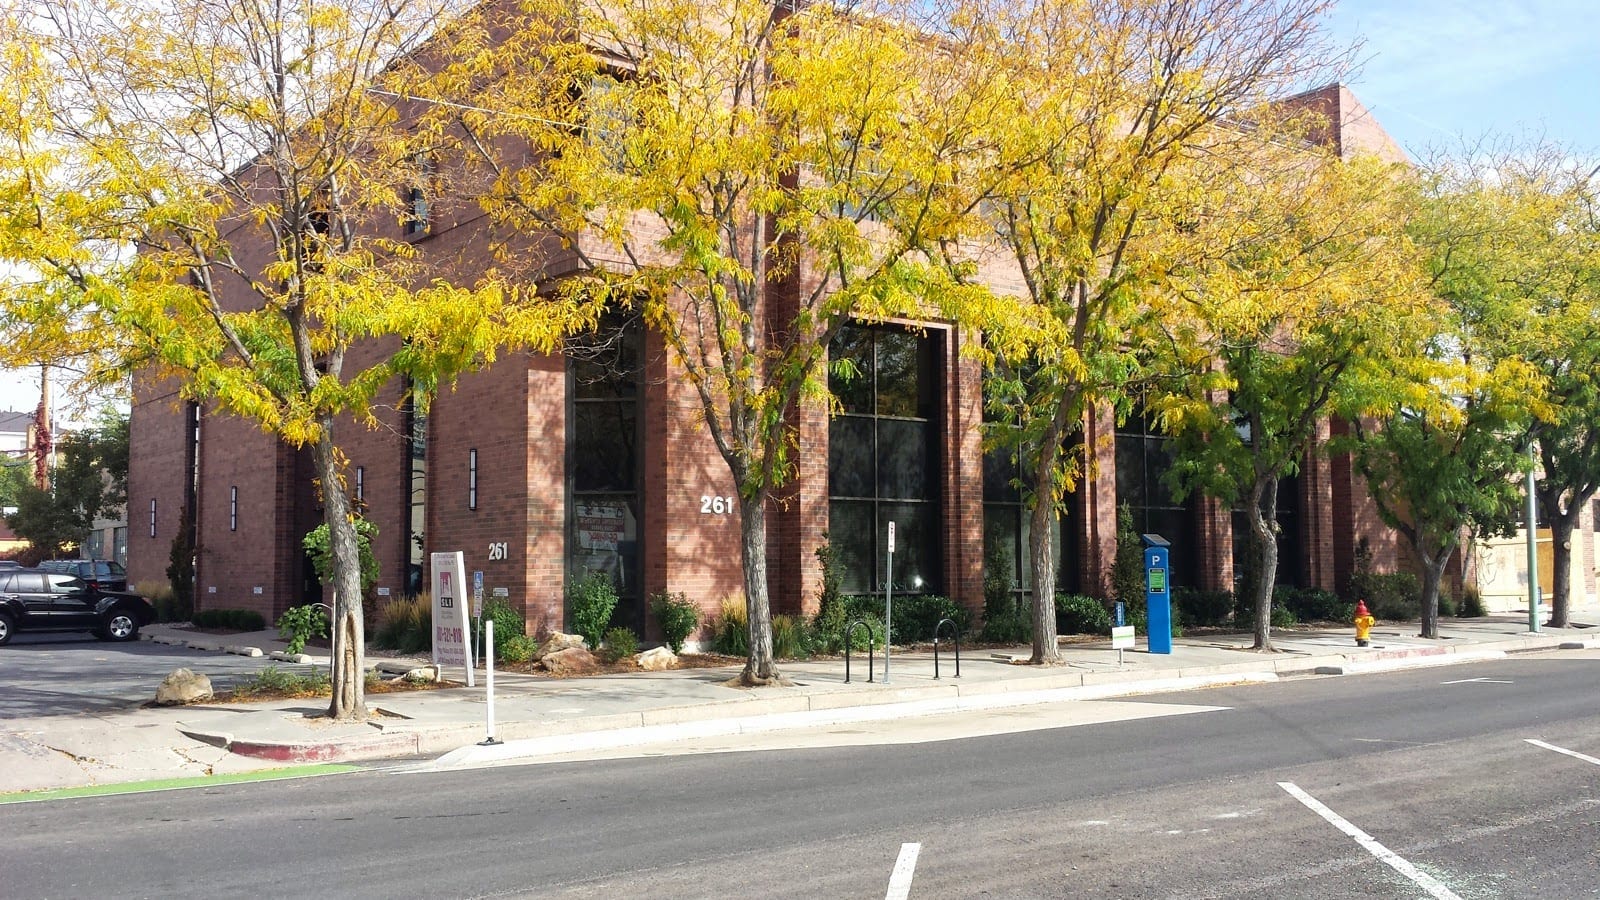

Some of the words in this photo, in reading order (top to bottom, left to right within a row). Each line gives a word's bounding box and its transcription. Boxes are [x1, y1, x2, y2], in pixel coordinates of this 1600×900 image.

[700, 495, 733, 514] 261
[488, 542, 508, 560] 261
[1151, 555, 1161, 566] P
